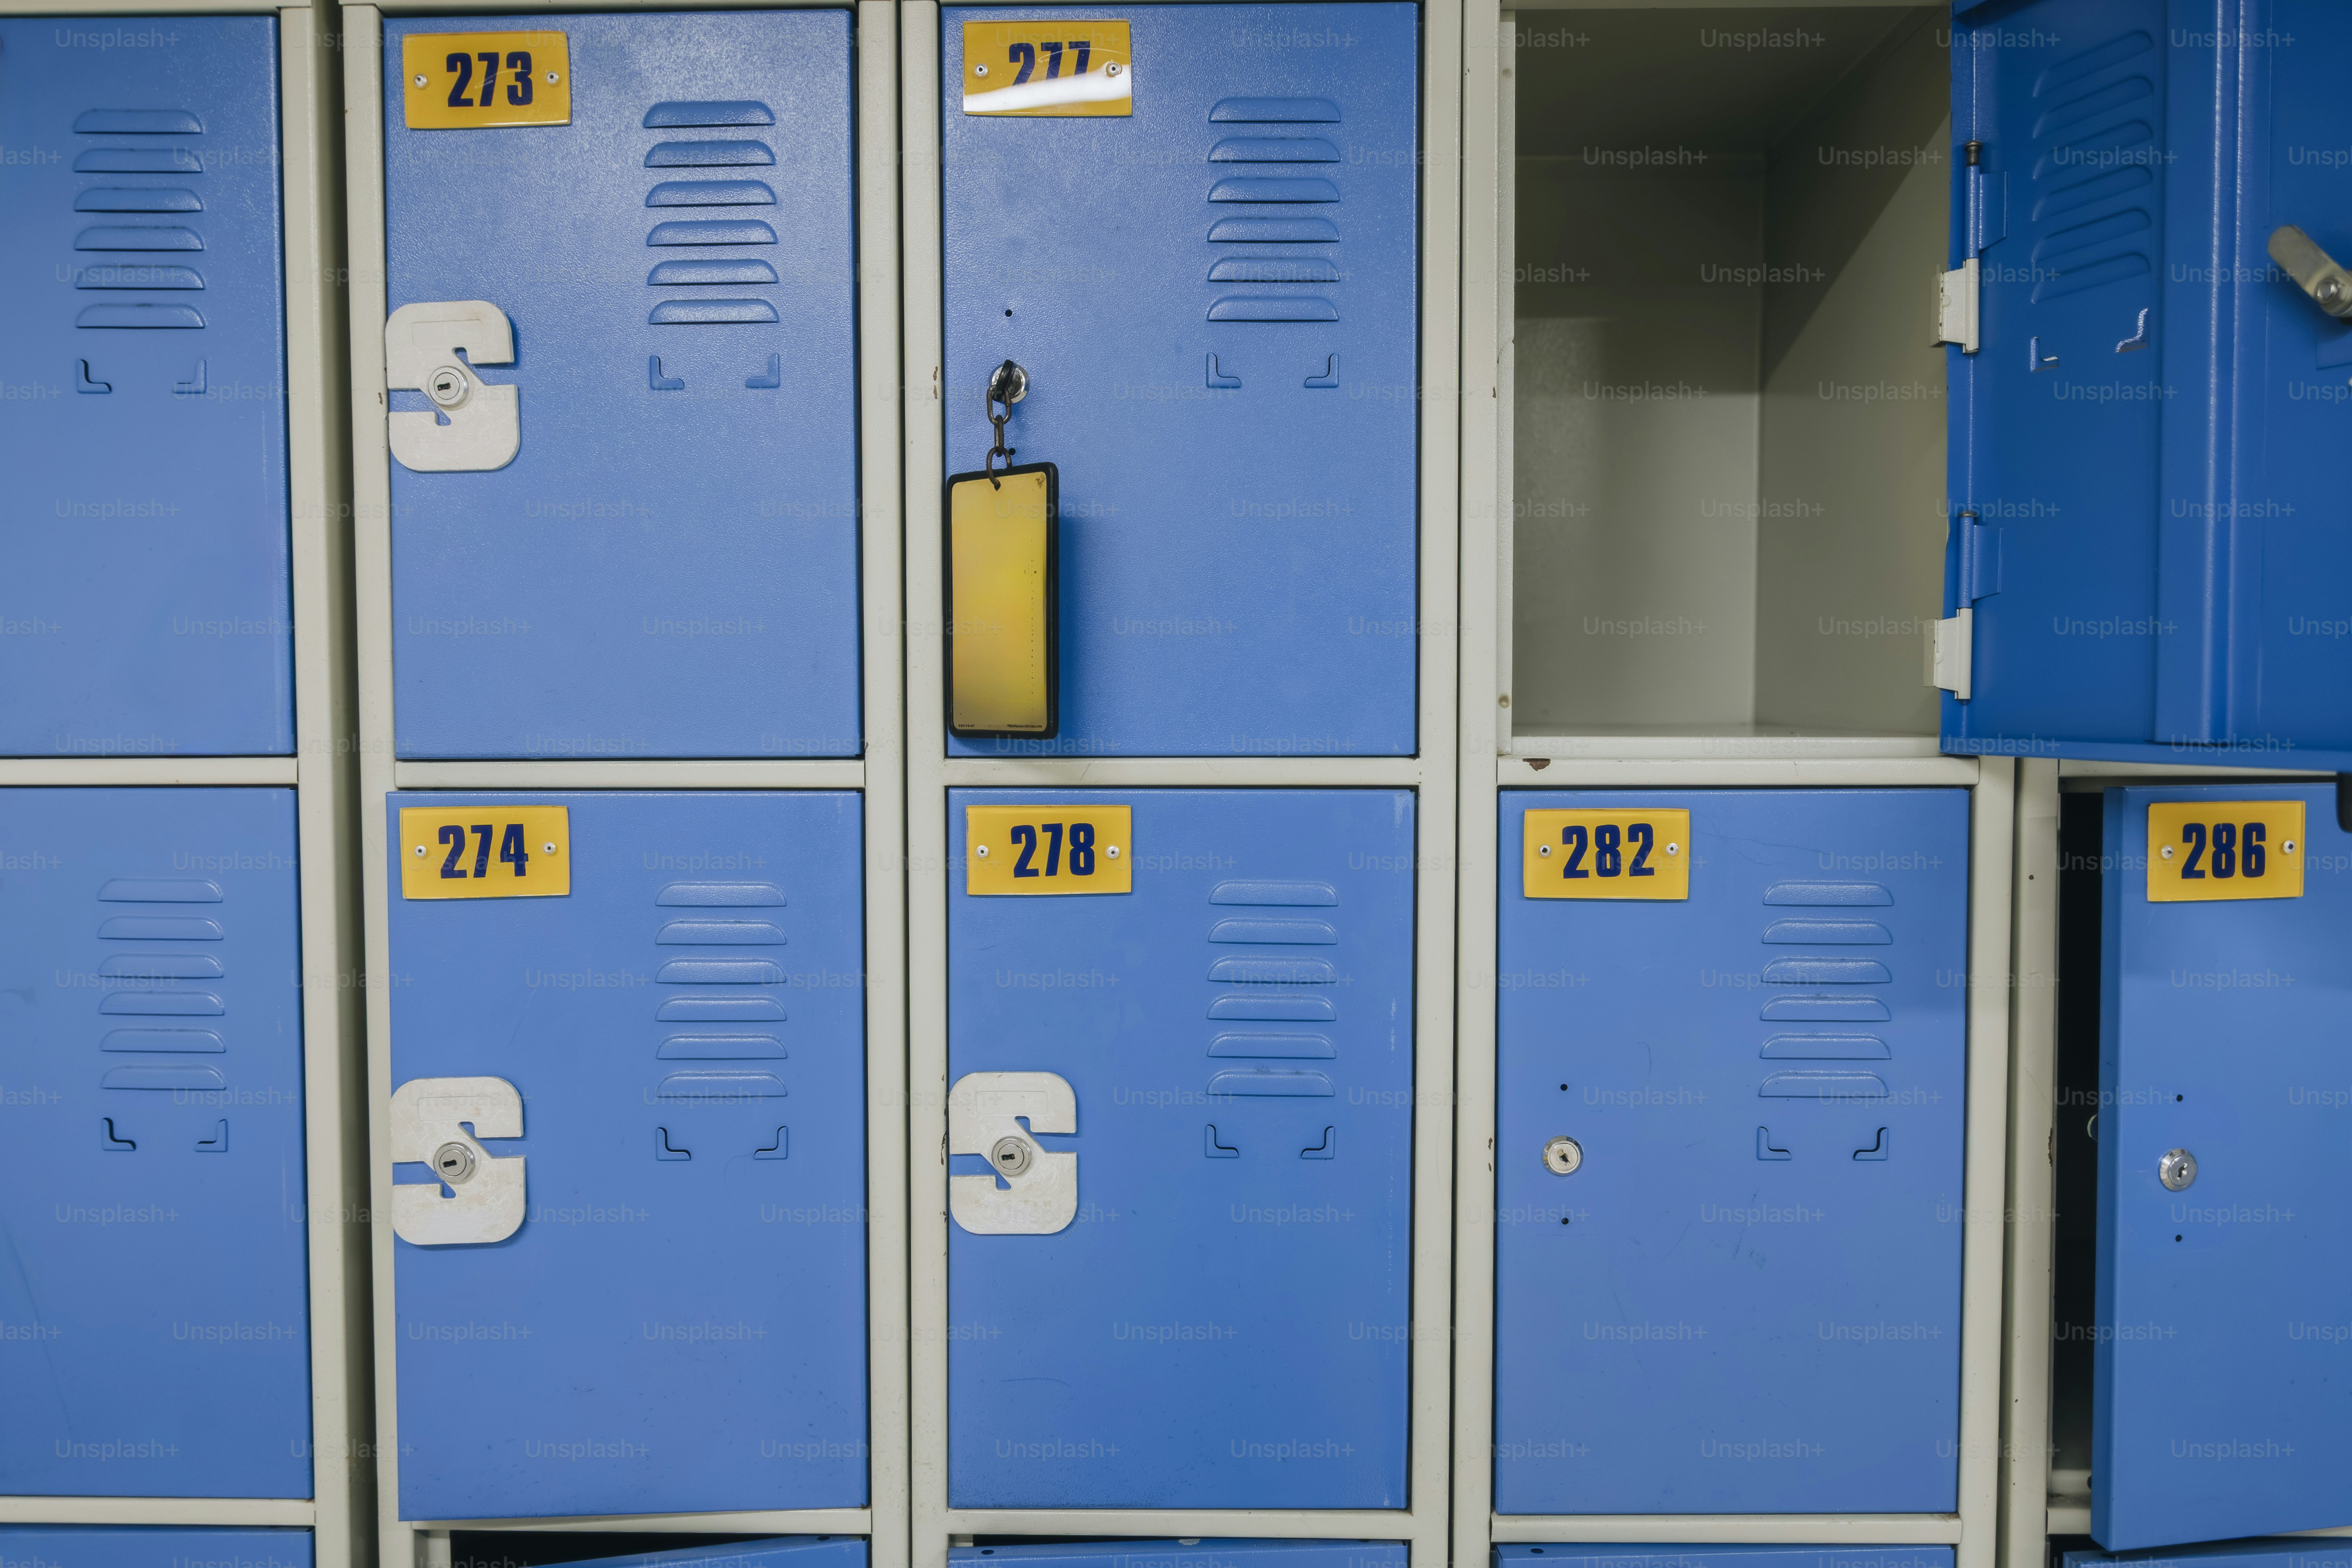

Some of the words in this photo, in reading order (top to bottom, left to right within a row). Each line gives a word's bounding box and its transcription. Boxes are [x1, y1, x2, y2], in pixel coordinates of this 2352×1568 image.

[446, 51, 532, 107] 273
[1009, 41, 1090, 86] 277
[438, 824, 528, 879] 274
[1011, 823, 1095, 878] 278
[1562, 823, 1654, 879] 282
[2181, 822, 2266, 879] 286
